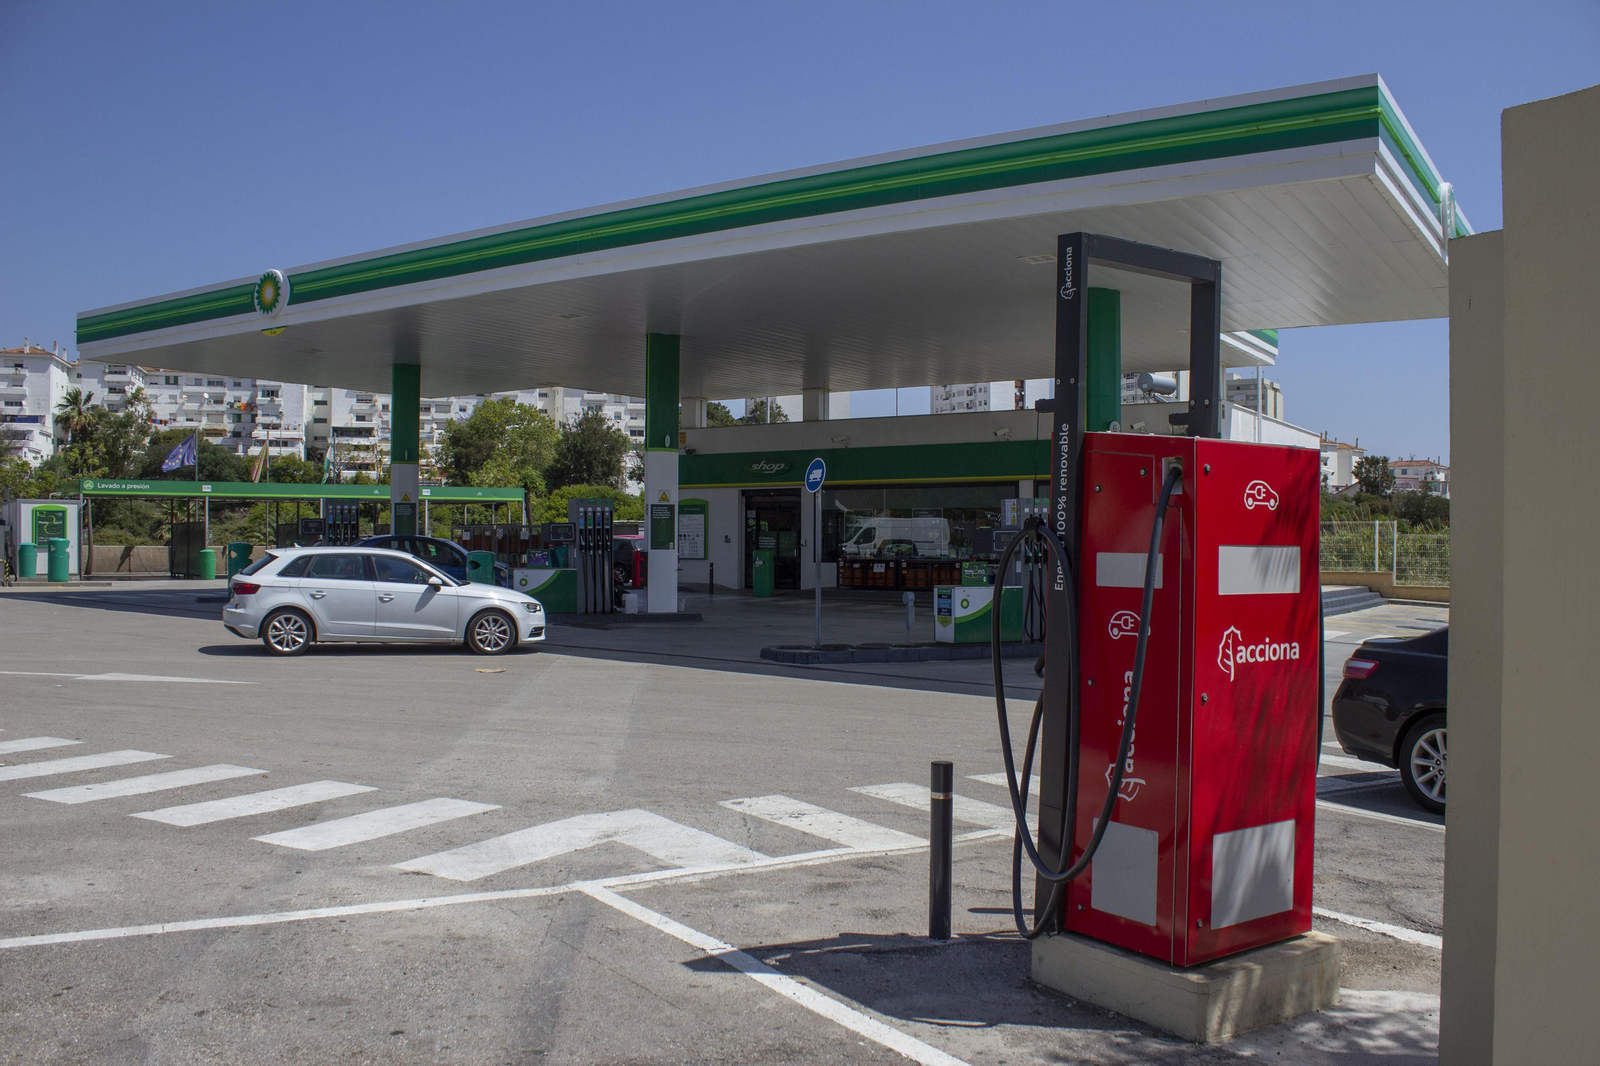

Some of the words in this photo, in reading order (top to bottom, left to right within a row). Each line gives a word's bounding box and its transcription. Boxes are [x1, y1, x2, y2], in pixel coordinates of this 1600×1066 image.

[1064, 246, 1073, 288] acciona
[751, 460, 785, 474] shop
[1059, 423, 1069, 491] renovable
[1056, 495, 1067, 537] 100%
[1236, 637, 1300, 663] acciona
